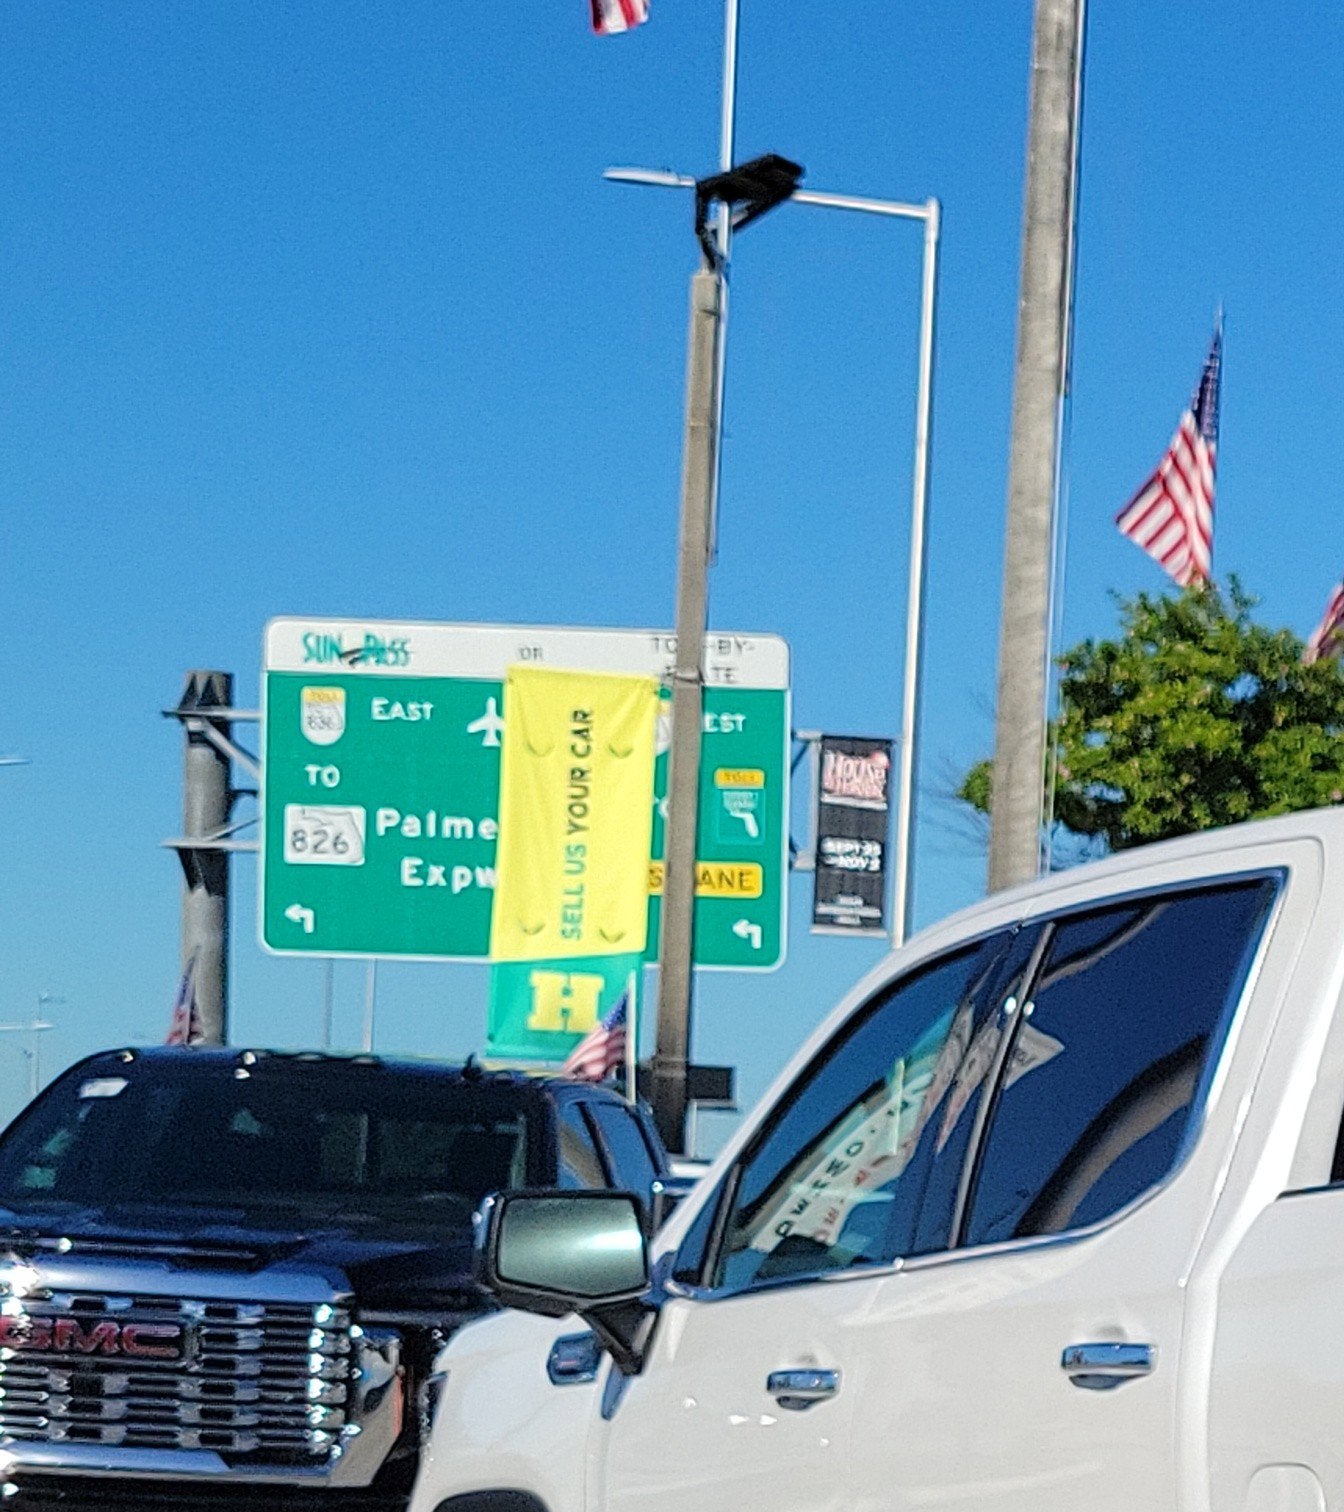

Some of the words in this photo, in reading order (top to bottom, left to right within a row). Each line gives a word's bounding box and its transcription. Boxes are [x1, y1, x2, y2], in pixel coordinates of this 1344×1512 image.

[371, 697, 434, 722] EAST
[703, 712, 746, 733] EST
[570, 709, 594, 759] CAR
[304, 763, 341, 788] TO
[567, 767, 592, 836] YOUR
[376, 807, 499, 840] Palme
[291, 829, 350, 855] 826
[400, 856, 498, 894] Expw
[565, 843, 587, 875] US
[694, 869, 758, 891] ANE
[562, 883, 585, 941] SELL
[0, 1318, 181, 1359] GMC
